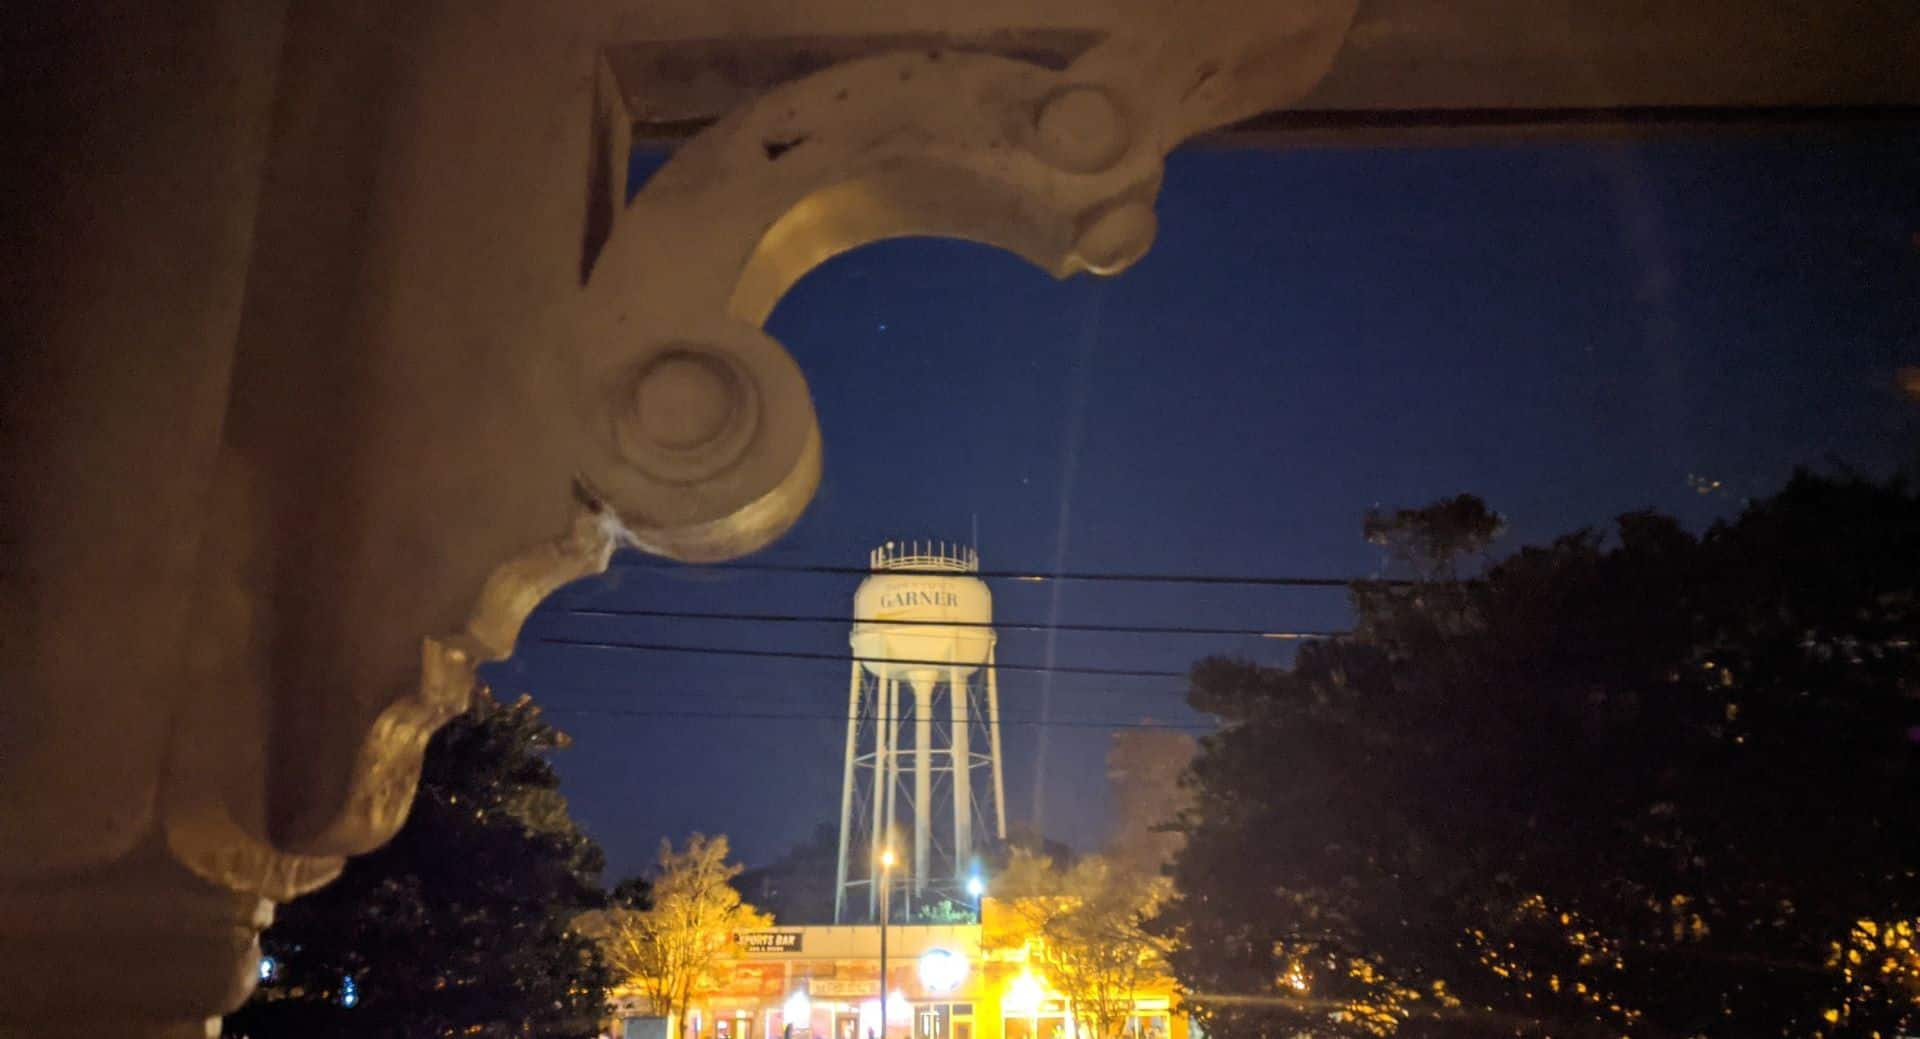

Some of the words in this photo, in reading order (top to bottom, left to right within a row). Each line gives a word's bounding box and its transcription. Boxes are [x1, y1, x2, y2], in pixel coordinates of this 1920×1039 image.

[880, 591, 958, 608] GARNER
[737, 934, 774, 946] SPORTS
[776, 934, 797, 947] BAR
